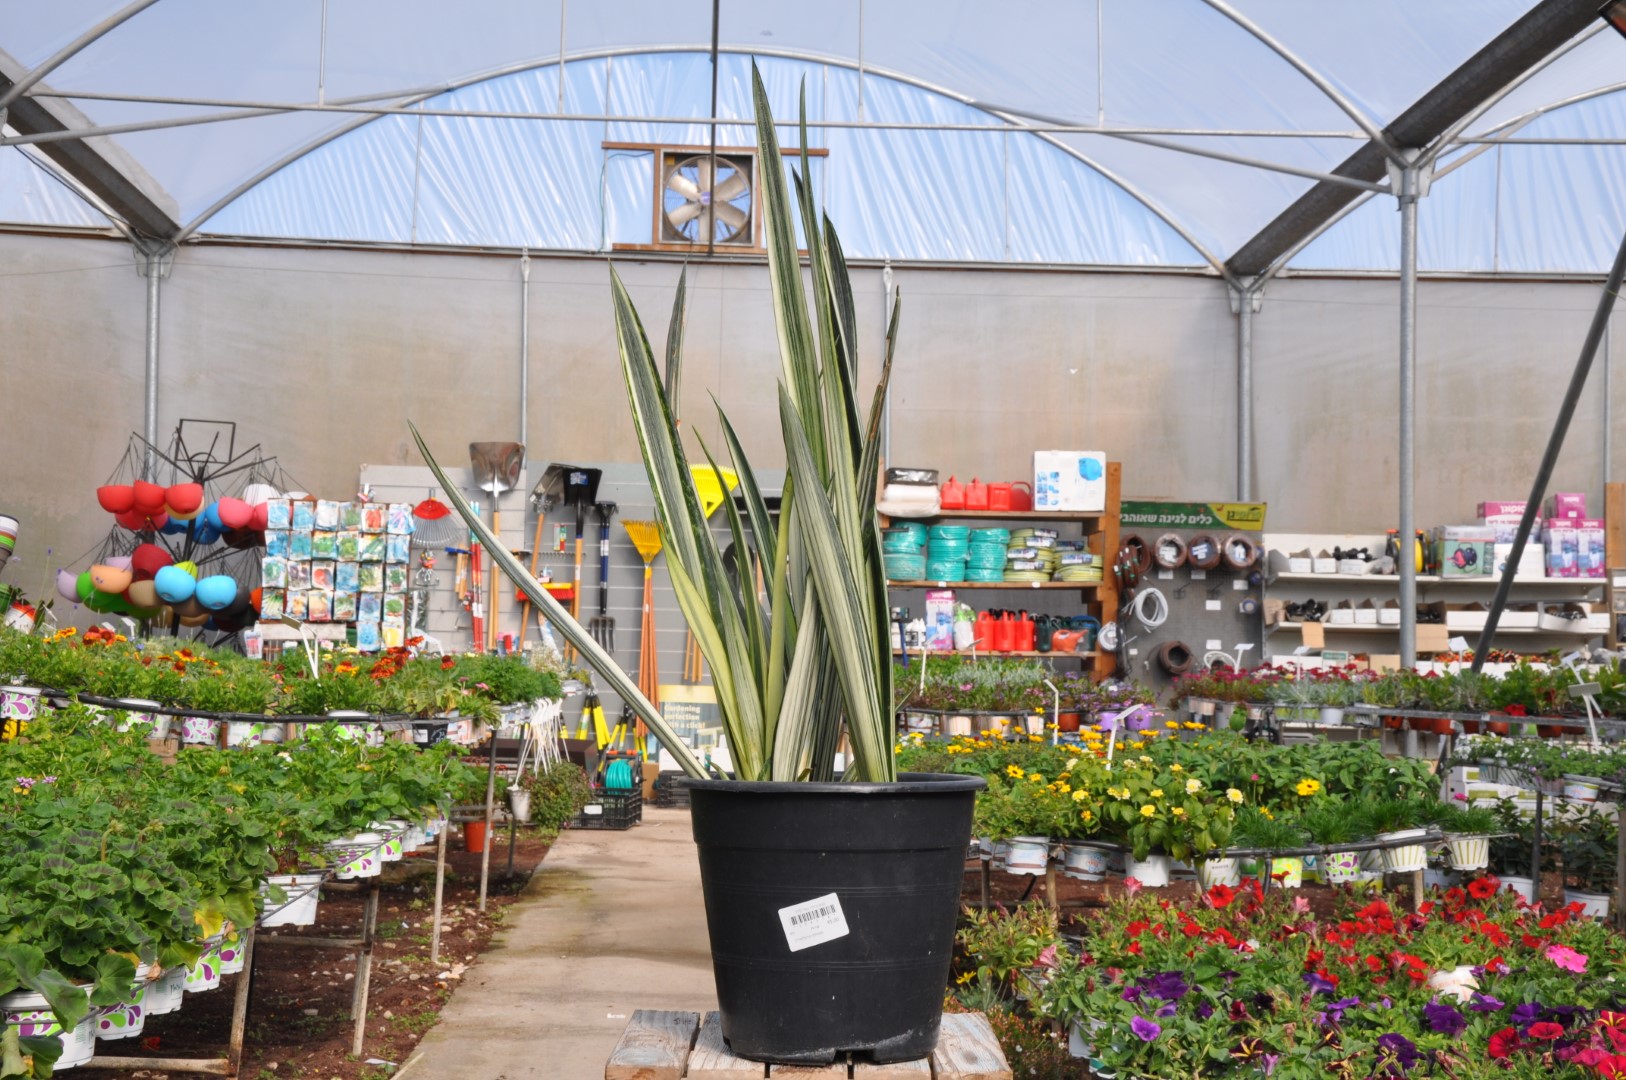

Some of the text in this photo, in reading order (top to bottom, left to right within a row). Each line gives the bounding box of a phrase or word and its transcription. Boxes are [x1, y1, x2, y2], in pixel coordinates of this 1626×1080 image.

[1120, 512, 1213, 525] כלים לגינה שאוהבי
[664, 705, 701, 714] Gardening
